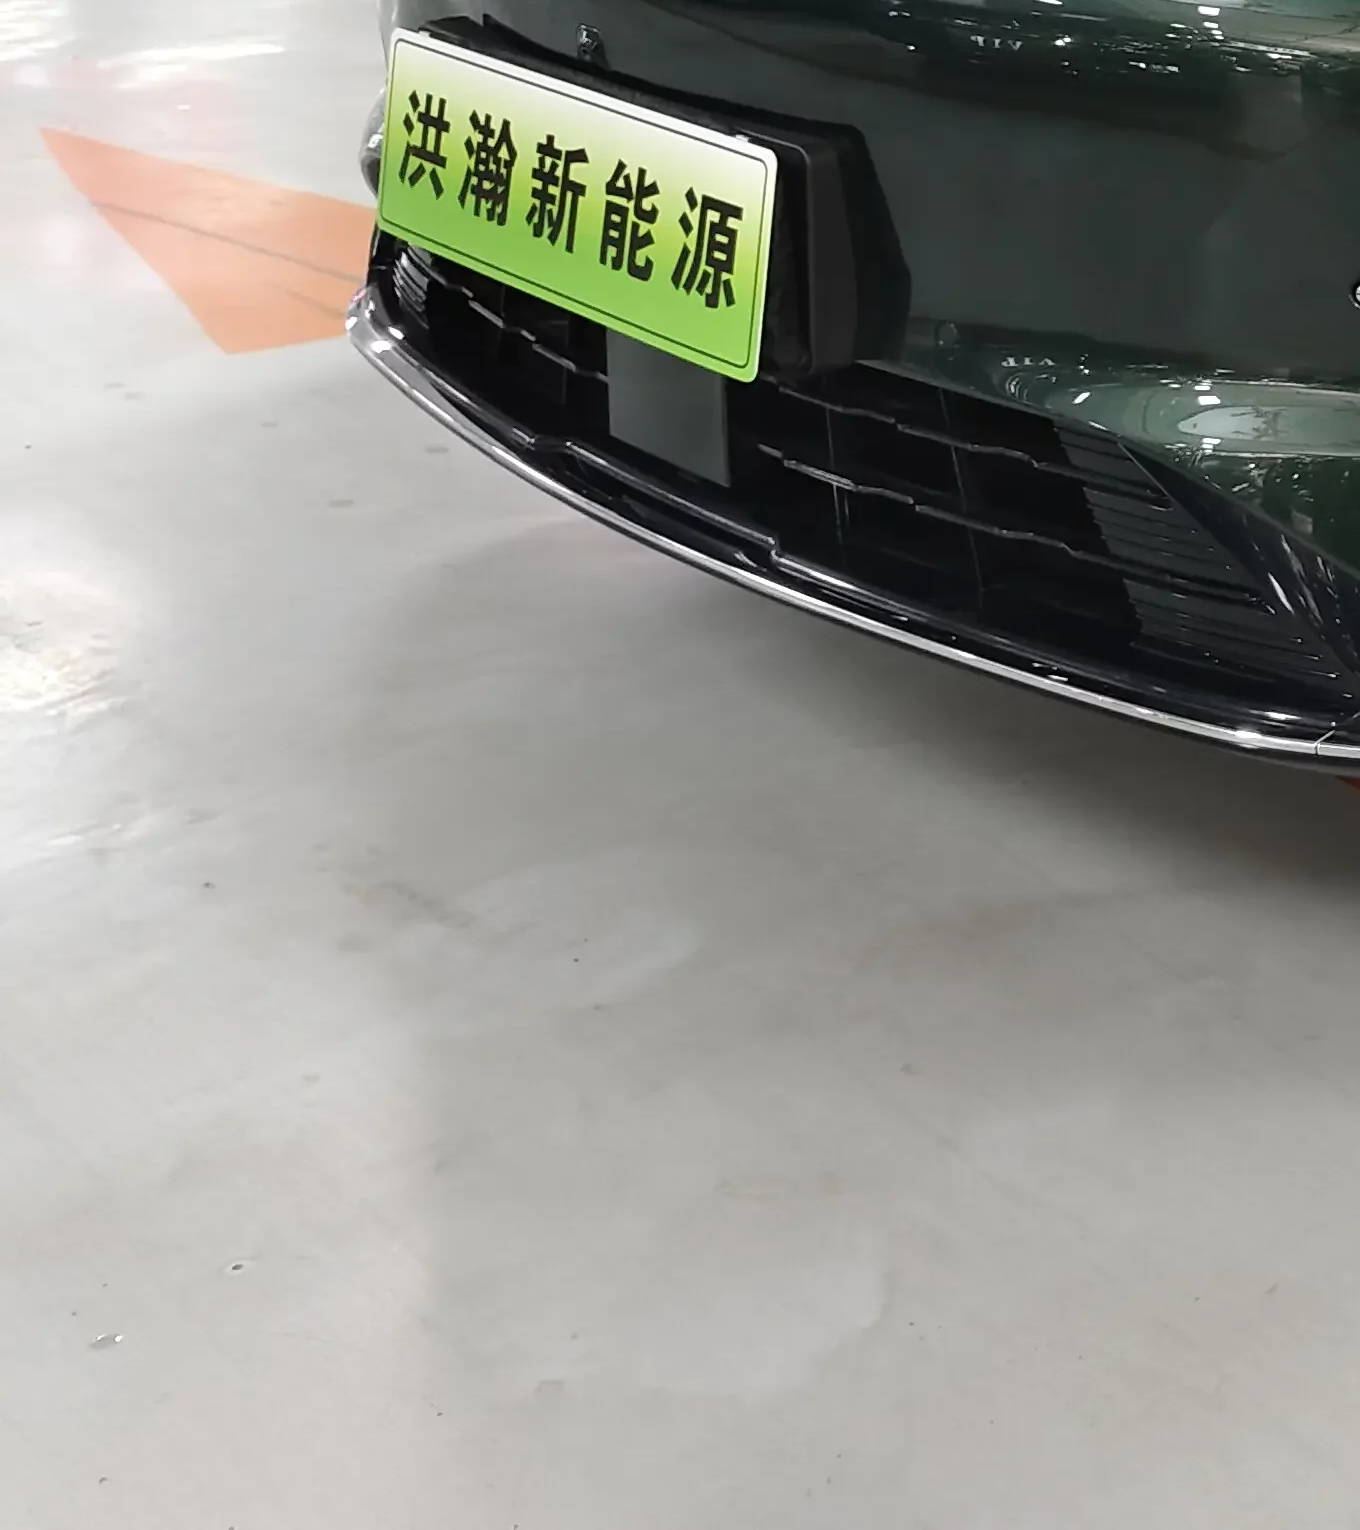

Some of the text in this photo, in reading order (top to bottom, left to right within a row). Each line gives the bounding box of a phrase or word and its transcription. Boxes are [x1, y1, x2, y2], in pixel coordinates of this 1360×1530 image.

[398, 88, 745, 310] 洪瀚新能源
